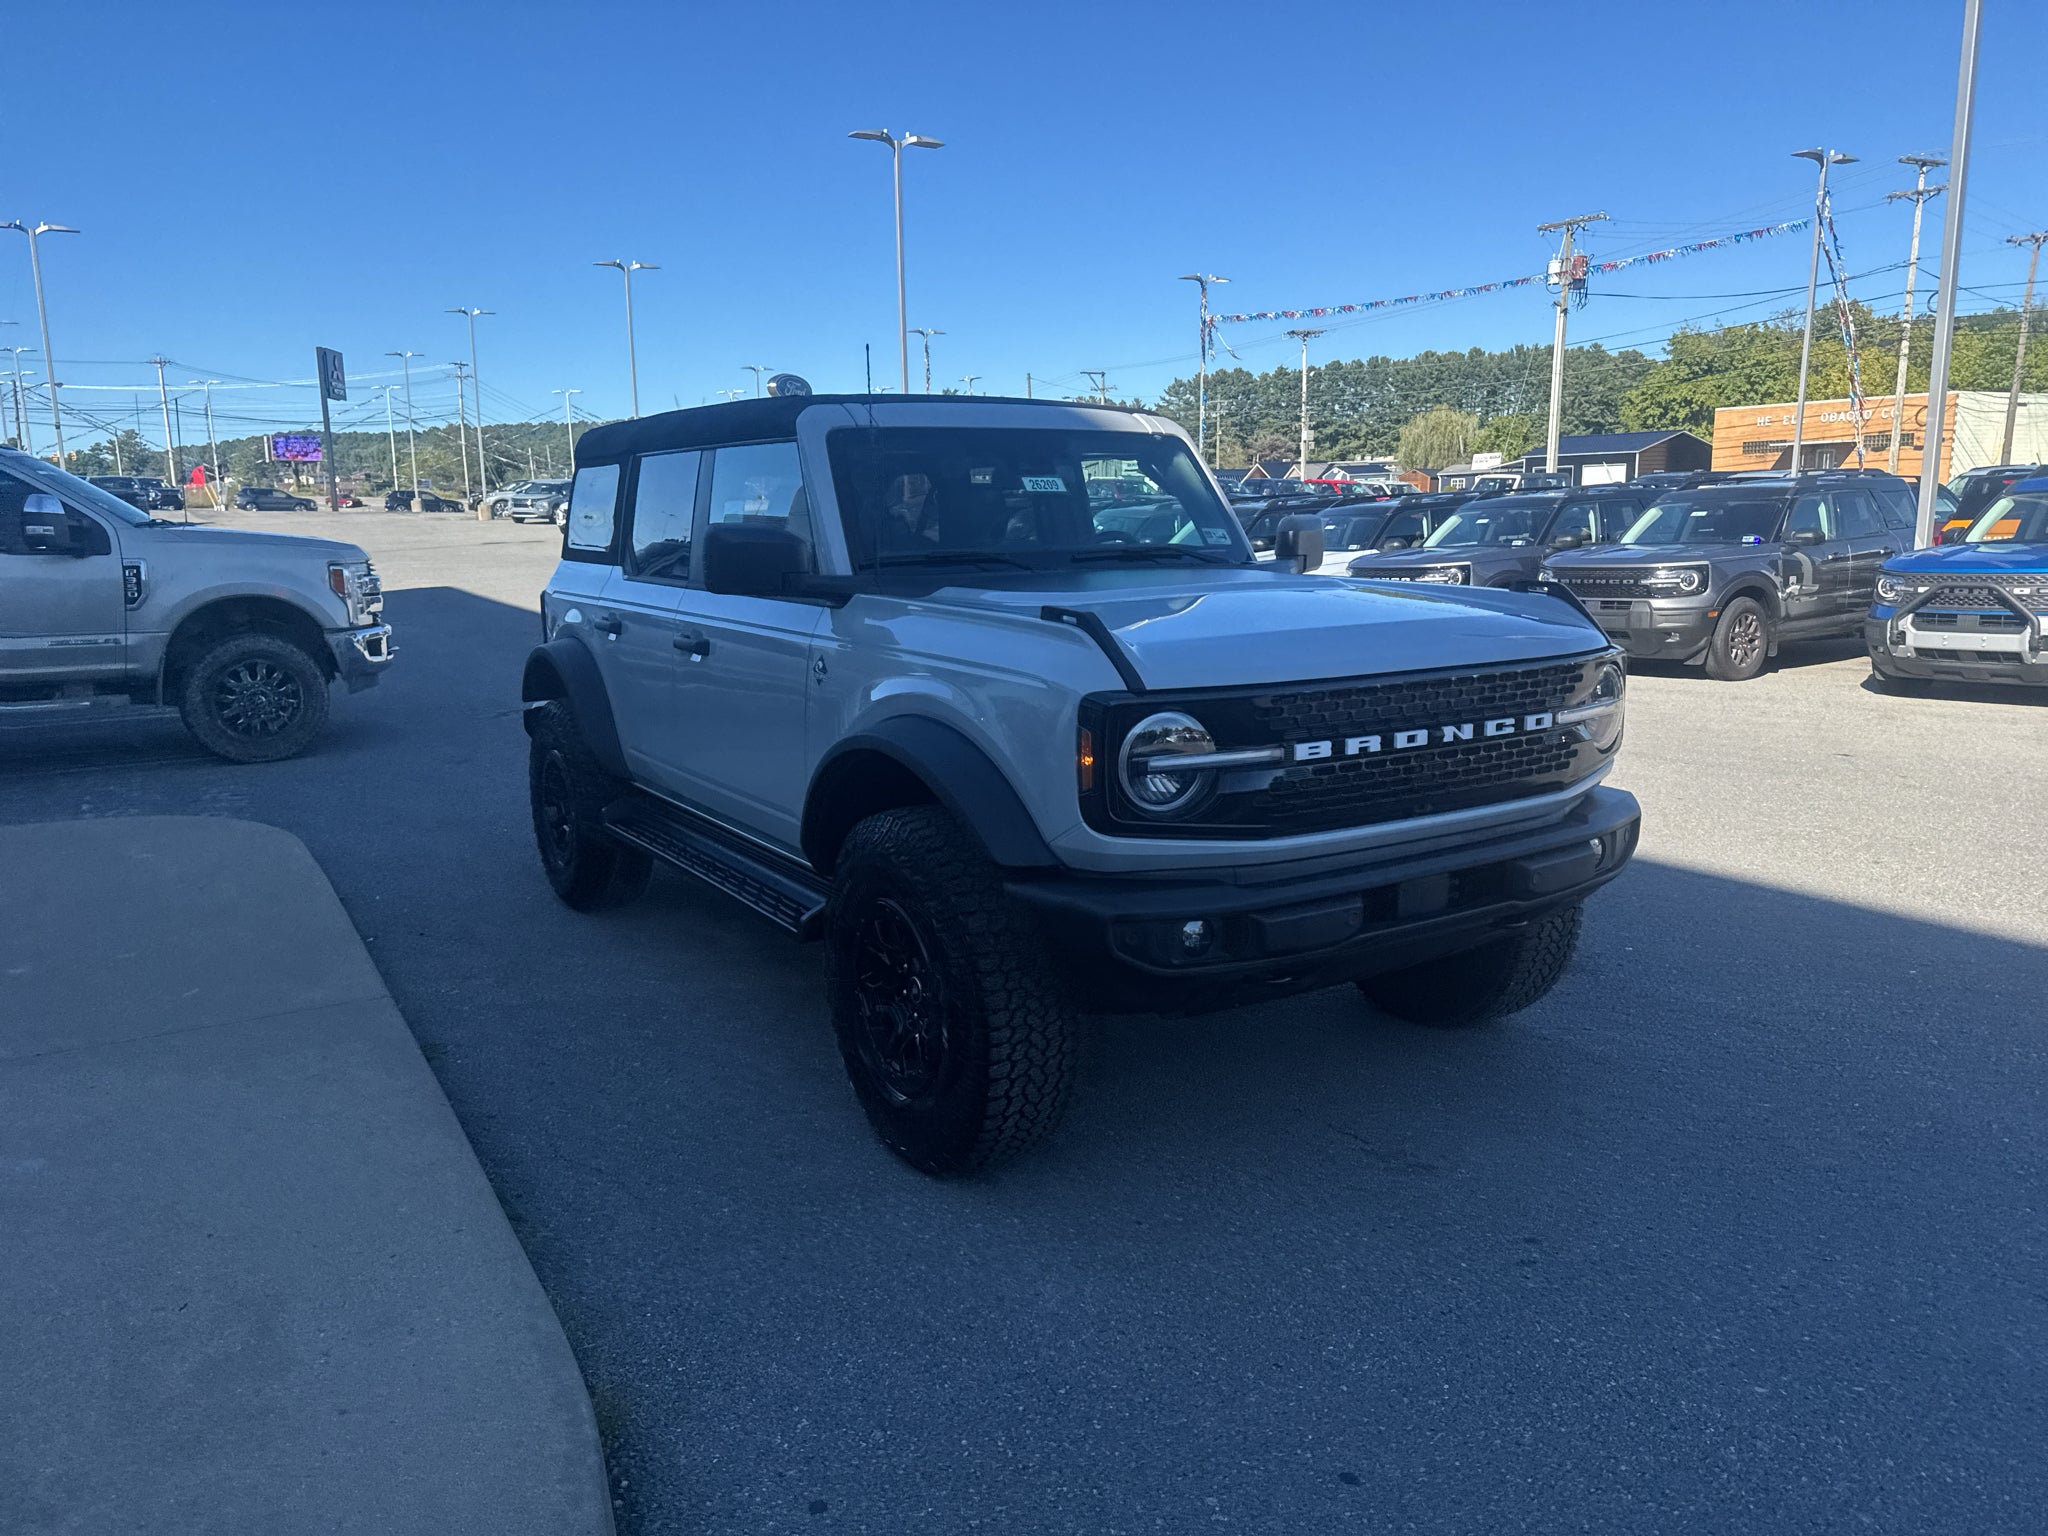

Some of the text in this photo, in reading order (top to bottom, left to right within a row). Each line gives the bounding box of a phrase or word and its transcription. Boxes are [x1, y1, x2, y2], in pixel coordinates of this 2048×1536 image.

[1783, 414, 1805, 425] EL
[1820, 410, 1872, 423] OBACO
[1028, 479, 1060, 490] 26209
[1294, 712, 1553, 761] BRONCO
